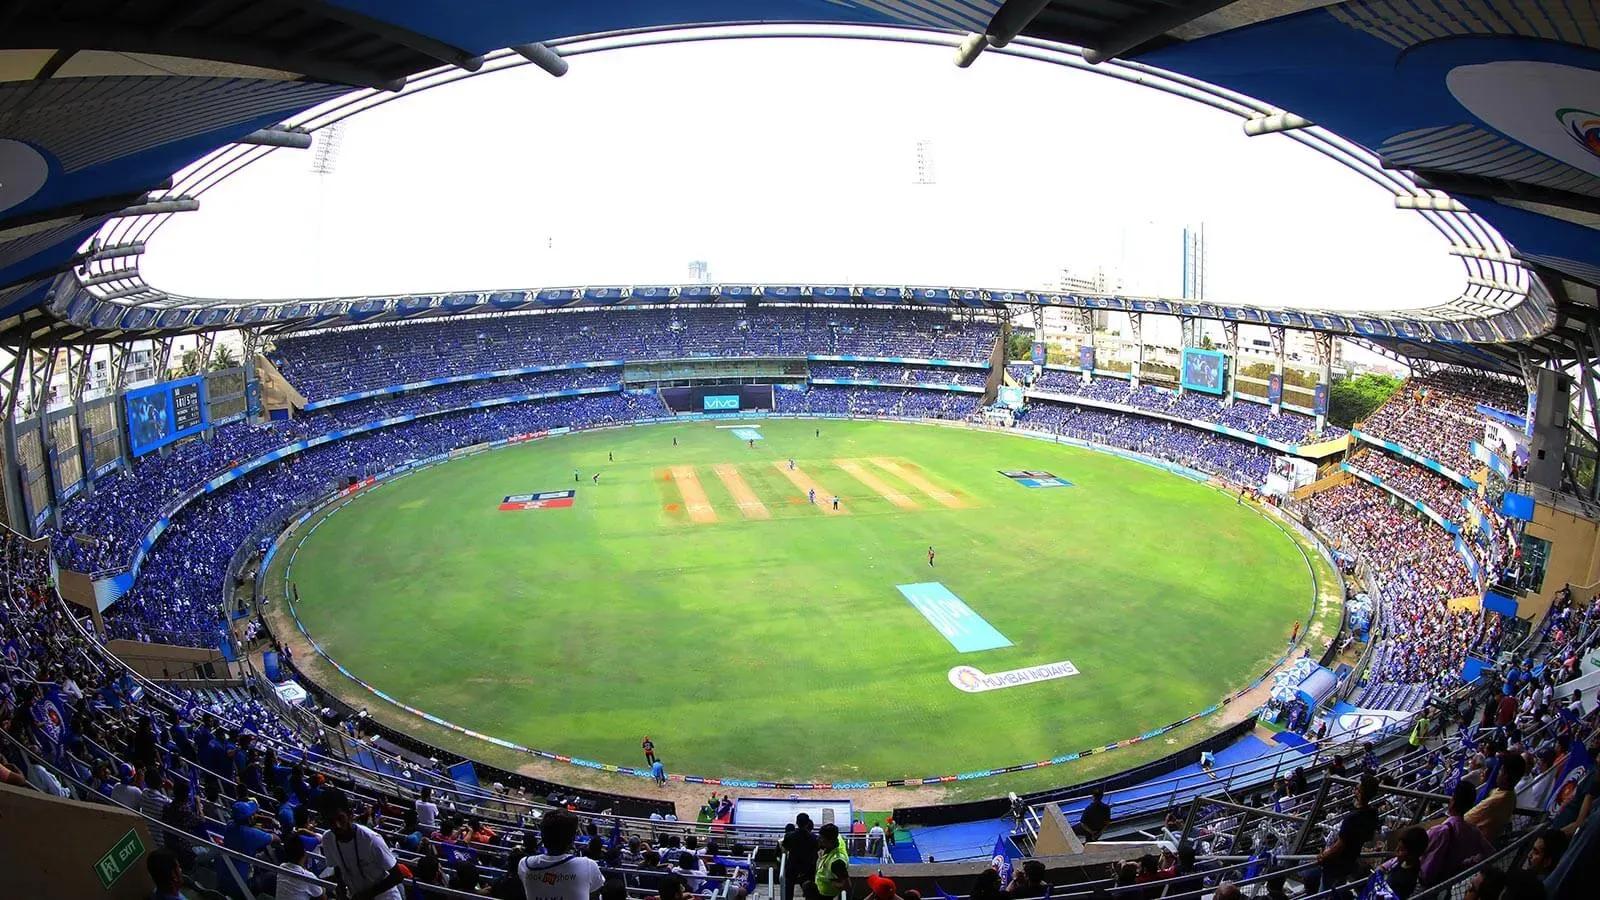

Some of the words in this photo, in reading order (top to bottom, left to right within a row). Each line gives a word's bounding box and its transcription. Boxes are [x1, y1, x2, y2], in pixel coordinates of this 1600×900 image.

[982, 673, 1029, 687] MUMBAI
[1029, 662, 1074, 680] INDIANS
[119, 839, 137, 861] EXIT
